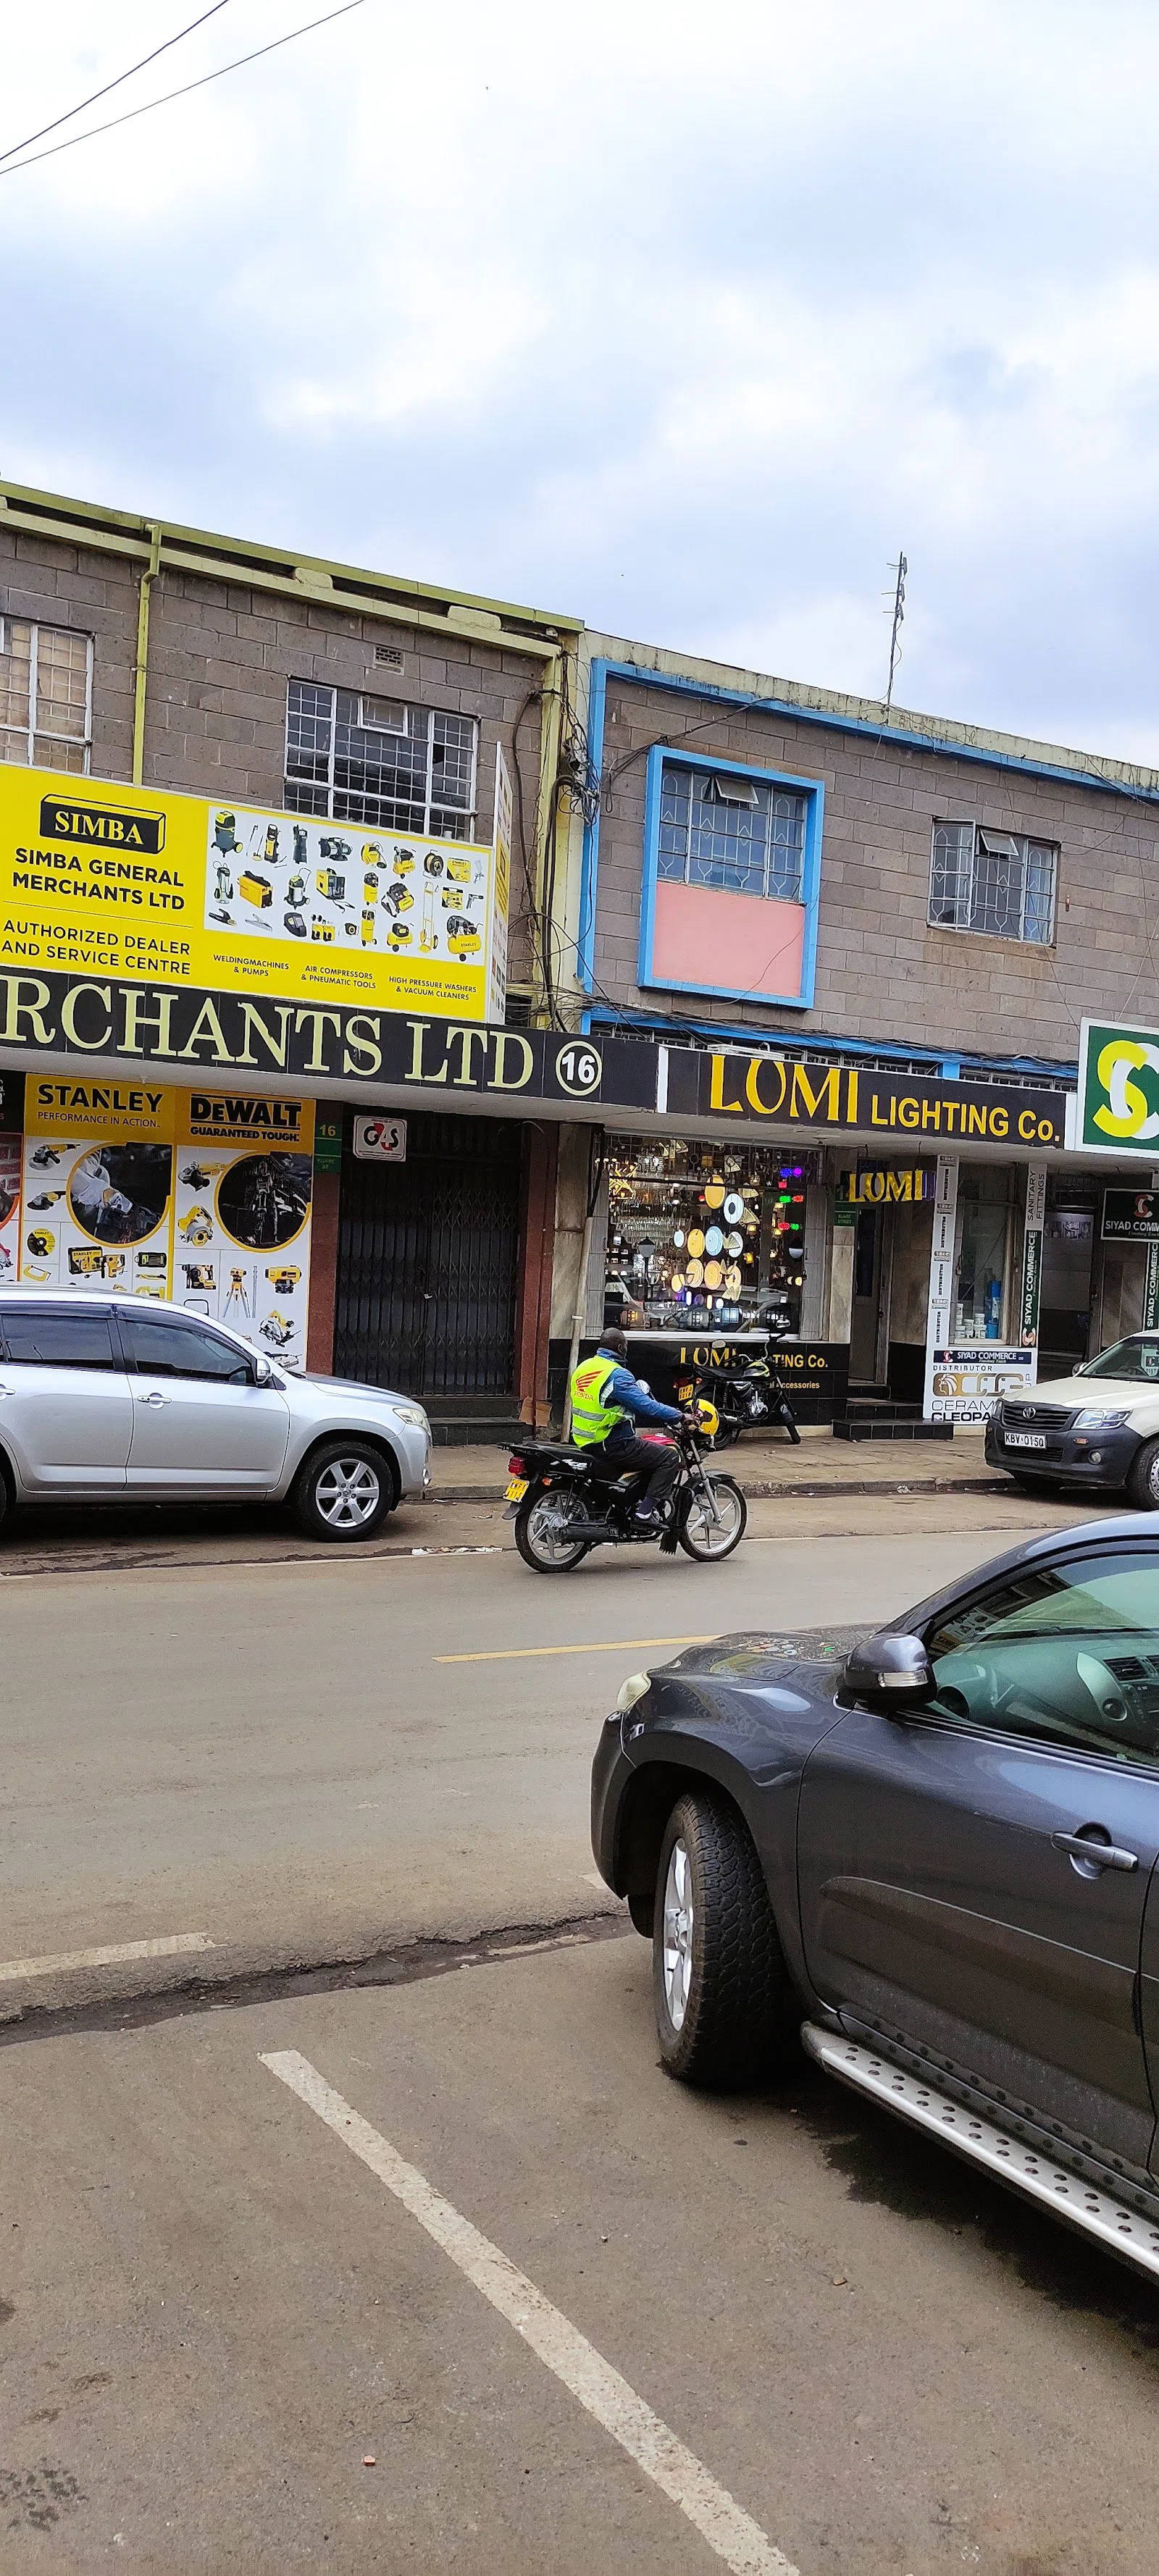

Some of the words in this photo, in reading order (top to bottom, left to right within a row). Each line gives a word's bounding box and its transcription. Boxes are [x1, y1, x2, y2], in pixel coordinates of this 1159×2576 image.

[55, 810, 144, 845] SIMBA
[15, 847, 82, 872] SIMBA
[88, 860, 184, 887] GENERAL
[13, 872, 143, 905] MERCHANTS
[148, 891, 185, 910] LTD
[4, 920, 119, 946] AUTHORIZED
[125, 935, 190, 955] DEALER
[1, 941, 40, 956] AND
[46, 946, 120, 966] SERVICE
[125, 955, 191, 975] CENTRE
[213, 954, 289, 970] WELDINGMACHINES
[242, 968, 269, 976] PUMPS
[309, 975, 351, 986] PNEUMATIC
[353, 980, 376, 989] TOOLS
[319, 967, 373, 980] COMPRESSORS
[409, 978, 443, 989] PRESSURE
[445, 983, 477, 993] WASHERS
[404, 987, 434, 996] VACUUM
[436, 991, 469, 1000] CLEANERS
[405, 1022, 533, 1089] LTD
[562, 1051, 595, 1085] 16
[38, 1084, 163, 1112] STANLEY
[710, 1054, 859, 1124] LOMI
[871, 1094, 1008, 1137] LIGHTING
[1017, 1110, 1060, 1142] Co.
[38, 1112, 107, 1123] PERFORMANCE
[122, 1117, 156, 1128] ACTION
[190, 1126, 259, 1139] GUARANTEED
[319, 1124, 336, 1136] 16
[364, 1123, 399, 1151] G4S
[849, 1170, 923, 1202] LOMI
[1027, 1170, 1037, 1221] SANITARY
[1036, 1173, 1045, 1220] FITTINGS
[1105, 1220, 1131, 1230] SIYAD
[1026, 1231, 1036, 1292] COMMERCE
[1150, 1242, 1159, 1296] COMMERC
[1024, 1294, 1033, 1325] SIYAD
[808, 1354, 829, 1368] Co.
[932, 1400, 995, 1411] CERAM
[932, 1412, 991, 1422] CLEOPA
[1005, 1434, 1020, 1443] KBV
[1024, 1436, 1044, 1447] 015Q
